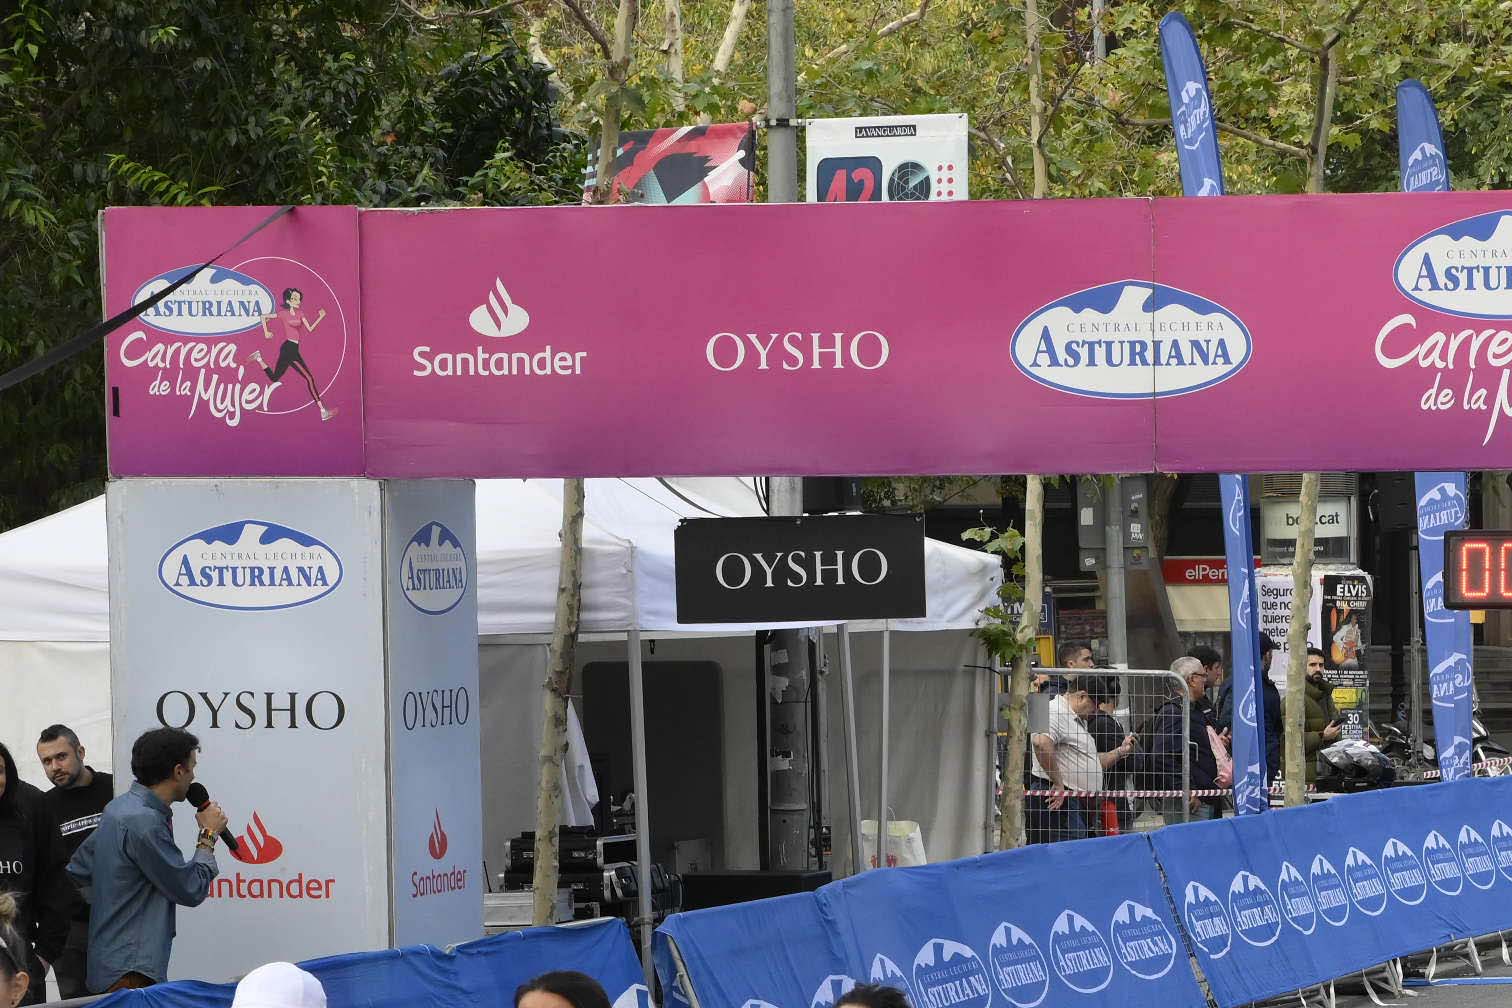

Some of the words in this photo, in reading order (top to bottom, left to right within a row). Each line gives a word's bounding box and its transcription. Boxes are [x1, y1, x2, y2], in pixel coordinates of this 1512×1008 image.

[865, 126, 916, 137] VANGUARDIA
[143, 290, 263, 318] ASTURIANA
[171, 289, 208, 297] ENTRAL
[1066, 322, 1141, 334] CENTRAL
[1150, 321, 1225, 333] LECHERA
[119, 331, 238, 369] Carrera
[412, 345, 588, 377] Santander
[705, 330, 890, 372] OYSHO
[1029, 324, 1233, 369] ASTURIANA
[149, 370, 171, 396] de
[175, 370, 191, 396] la
[187, 365, 283, 427] Mujer
[1420, 372, 1455, 411] de
[1463, 371, 1488, 411] la
[172, 553, 330, 588] ASTURIANA
[201, 552, 257, 561] CENTRAL
[264, 551, 324, 561] LECHERA
[715, 548, 888, 590] OYSHO
[406, 556, 463, 592] ASTURIANA
[1336, 584, 1367, 597] ELVIS
[156, 690, 346, 731] OYSHO
[403, 687, 470, 731] OYSHO
[1347, 713, 1360, 724] 30
[204, 873, 336, 900] antander
[411, 866, 467, 899] Santander
[995, 956, 1044, 990] ASTURIANA
[1056, 944, 1111, 976] ASTURIANA
